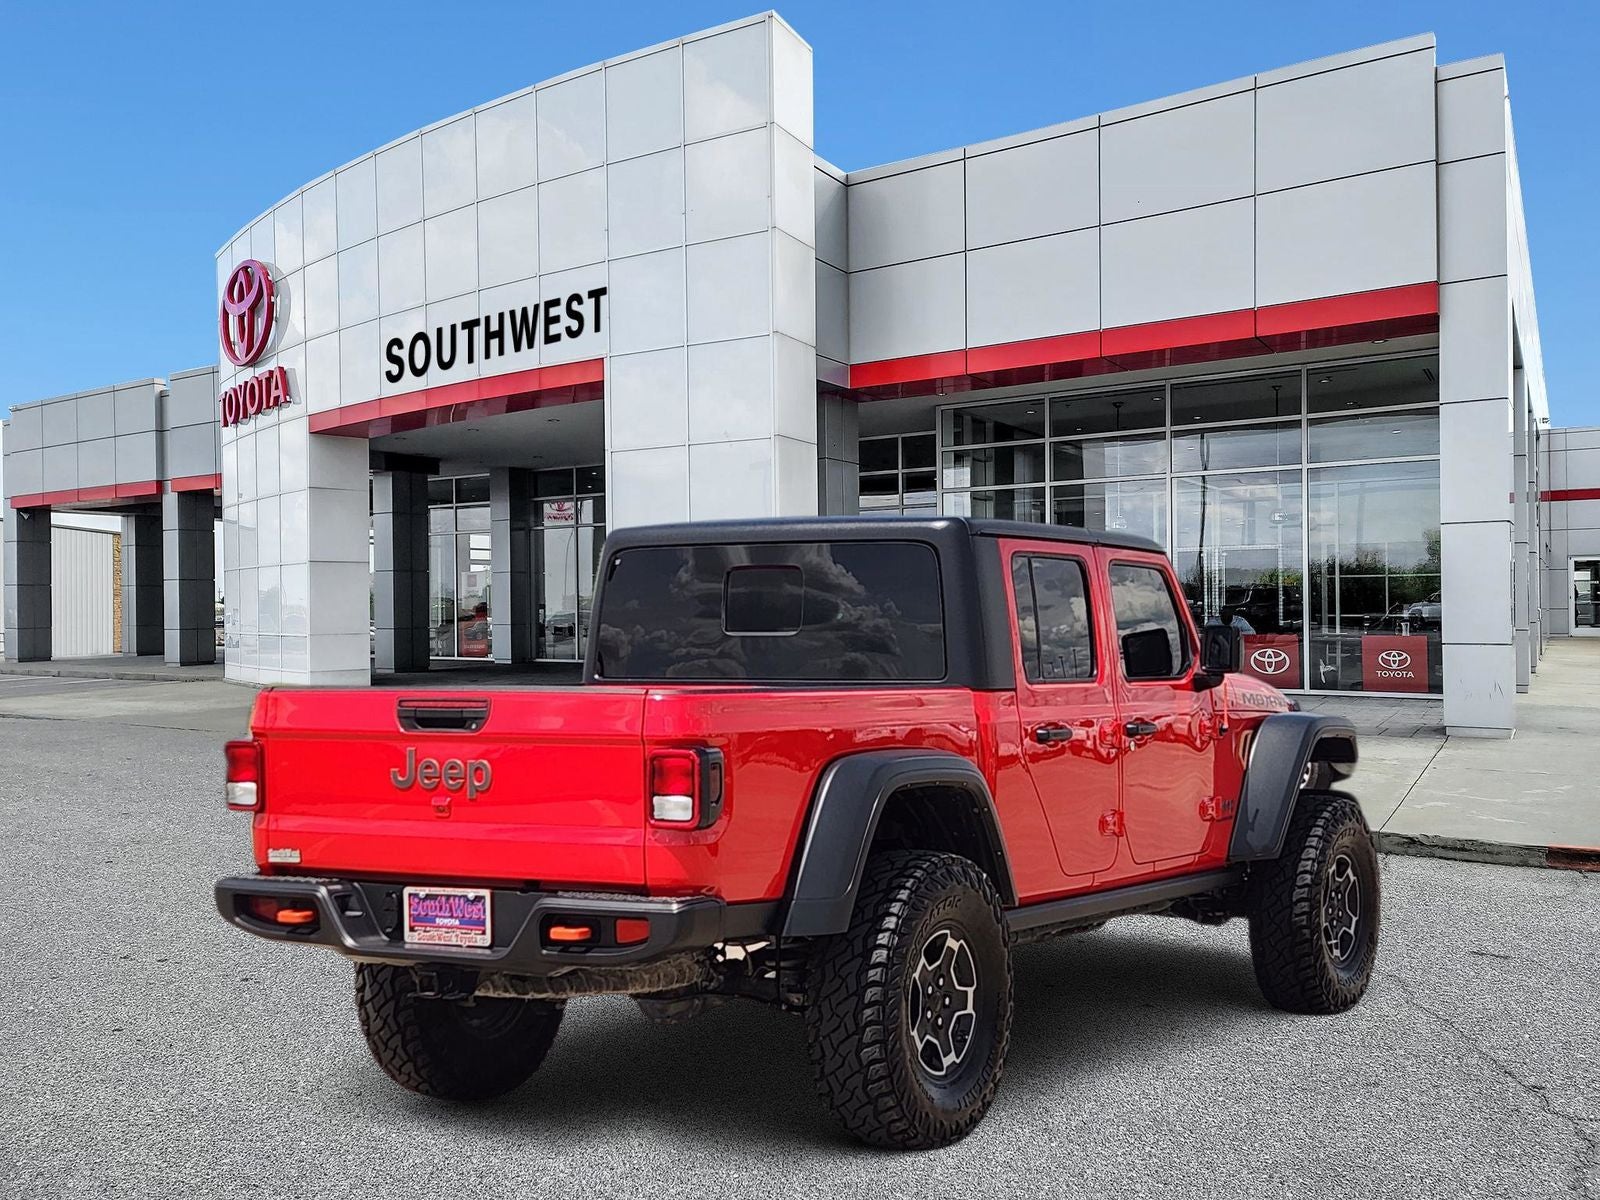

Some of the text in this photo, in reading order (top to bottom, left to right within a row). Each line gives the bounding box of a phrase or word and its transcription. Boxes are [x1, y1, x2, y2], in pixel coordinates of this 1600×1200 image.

[384, 286, 608, 384] SOUTHWEST
[219, 366, 292, 428] TOYOTA
[1376, 670, 1414, 678] TOYOTA
[390, 746, 492, 799] Jeep
[435, 917, 460, 925] TOYOTA
